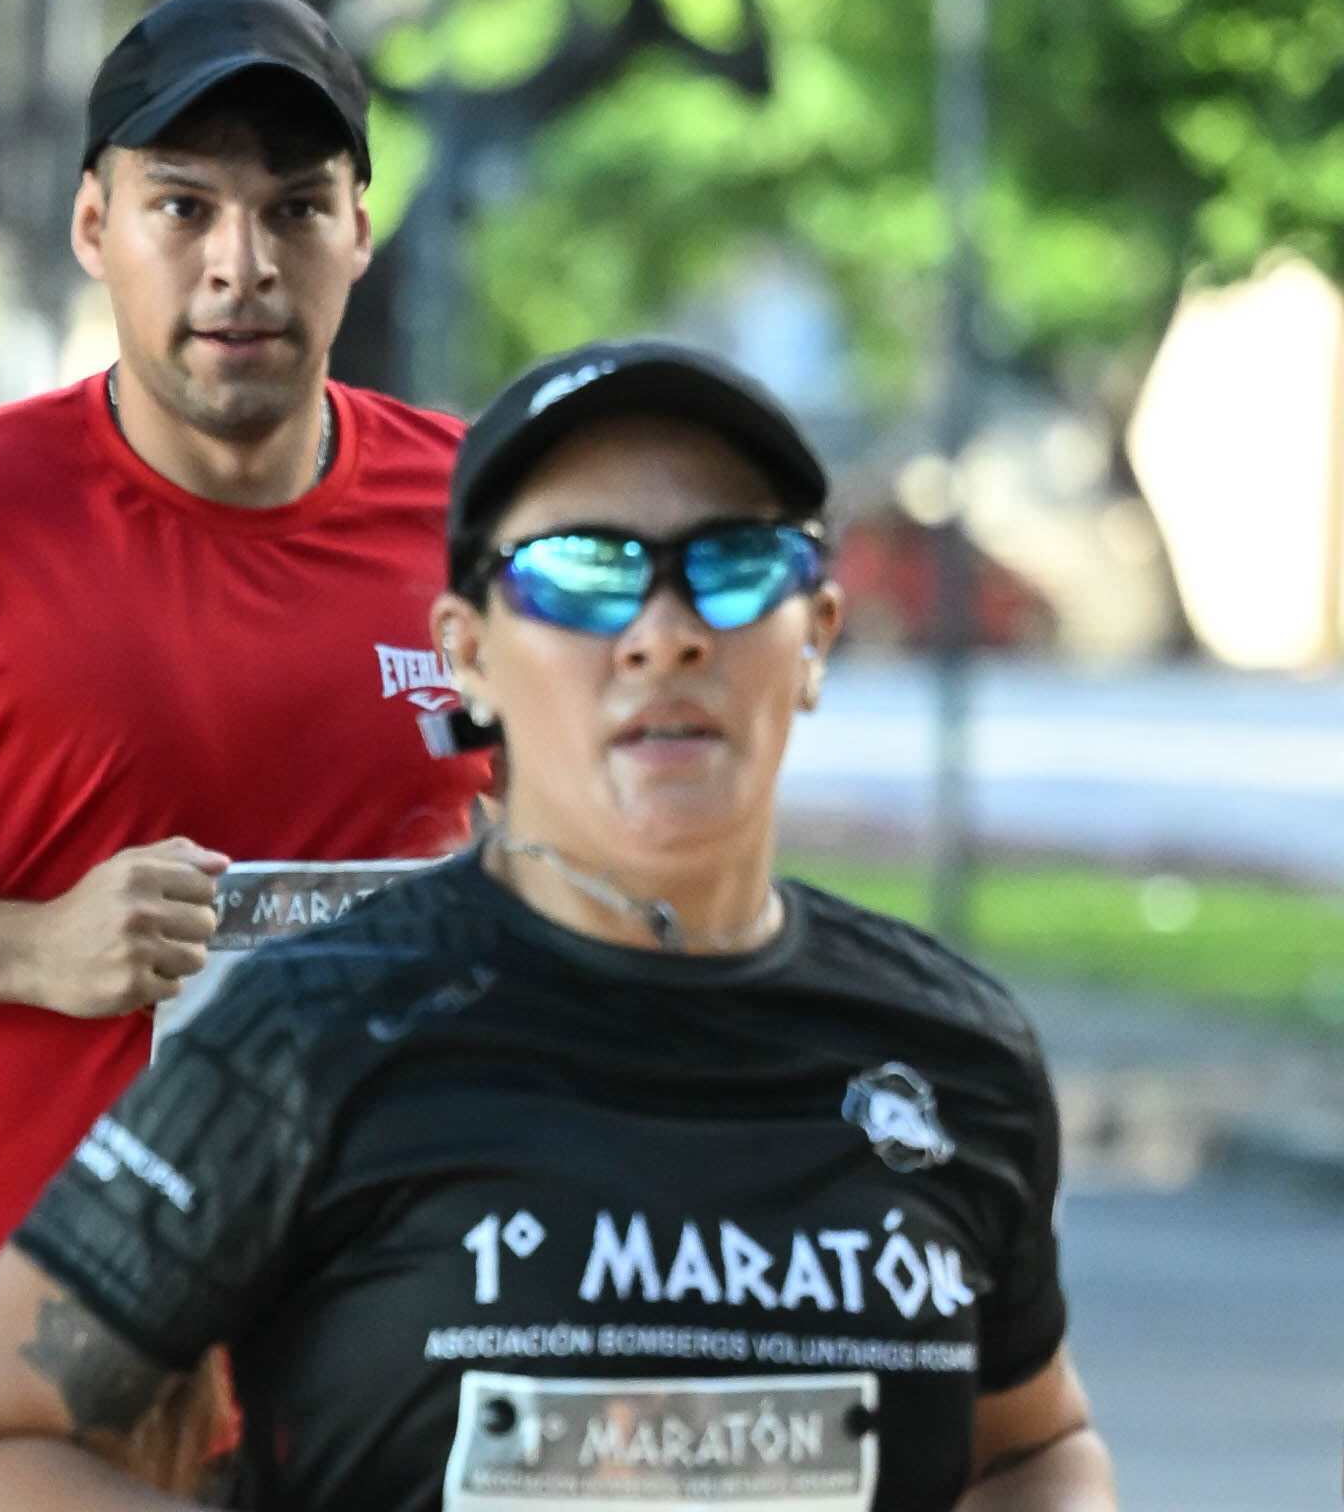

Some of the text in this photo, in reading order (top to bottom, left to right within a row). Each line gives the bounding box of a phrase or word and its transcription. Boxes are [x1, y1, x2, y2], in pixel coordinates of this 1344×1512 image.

[578, 1207, 976, 1320] MARATÓN
[424, 1322, 593, 1361] ASOCIACIÓN
[597, 1324, 750, 1361] BOMBEROS
[577, 1395, 825, 1469] MARATÓN
